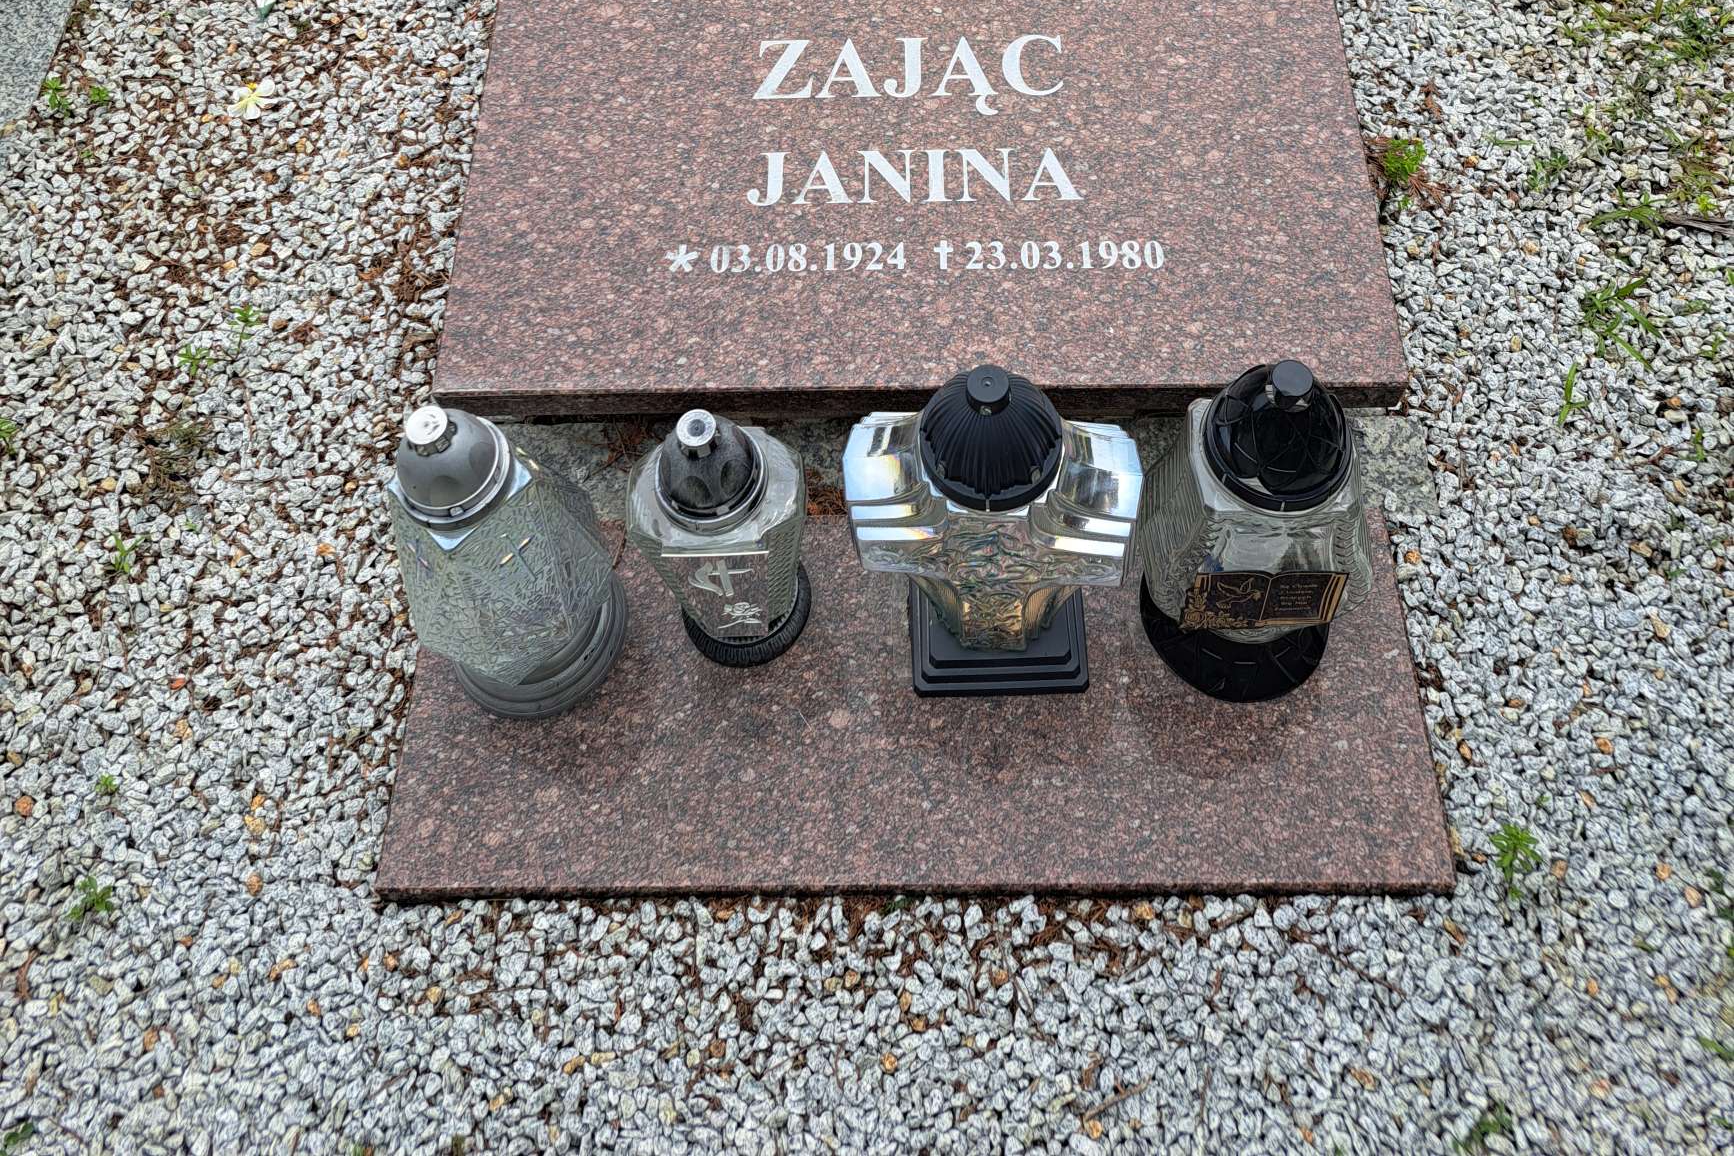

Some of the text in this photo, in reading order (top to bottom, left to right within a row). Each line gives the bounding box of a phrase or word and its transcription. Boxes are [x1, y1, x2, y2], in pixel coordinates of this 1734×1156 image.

[752, 34, 1064, 116] ZAJĄC
[746, 147, 1085, 207] JANINA
[709, 239, 1165, 274] 03.08.1924 23.03.1980
